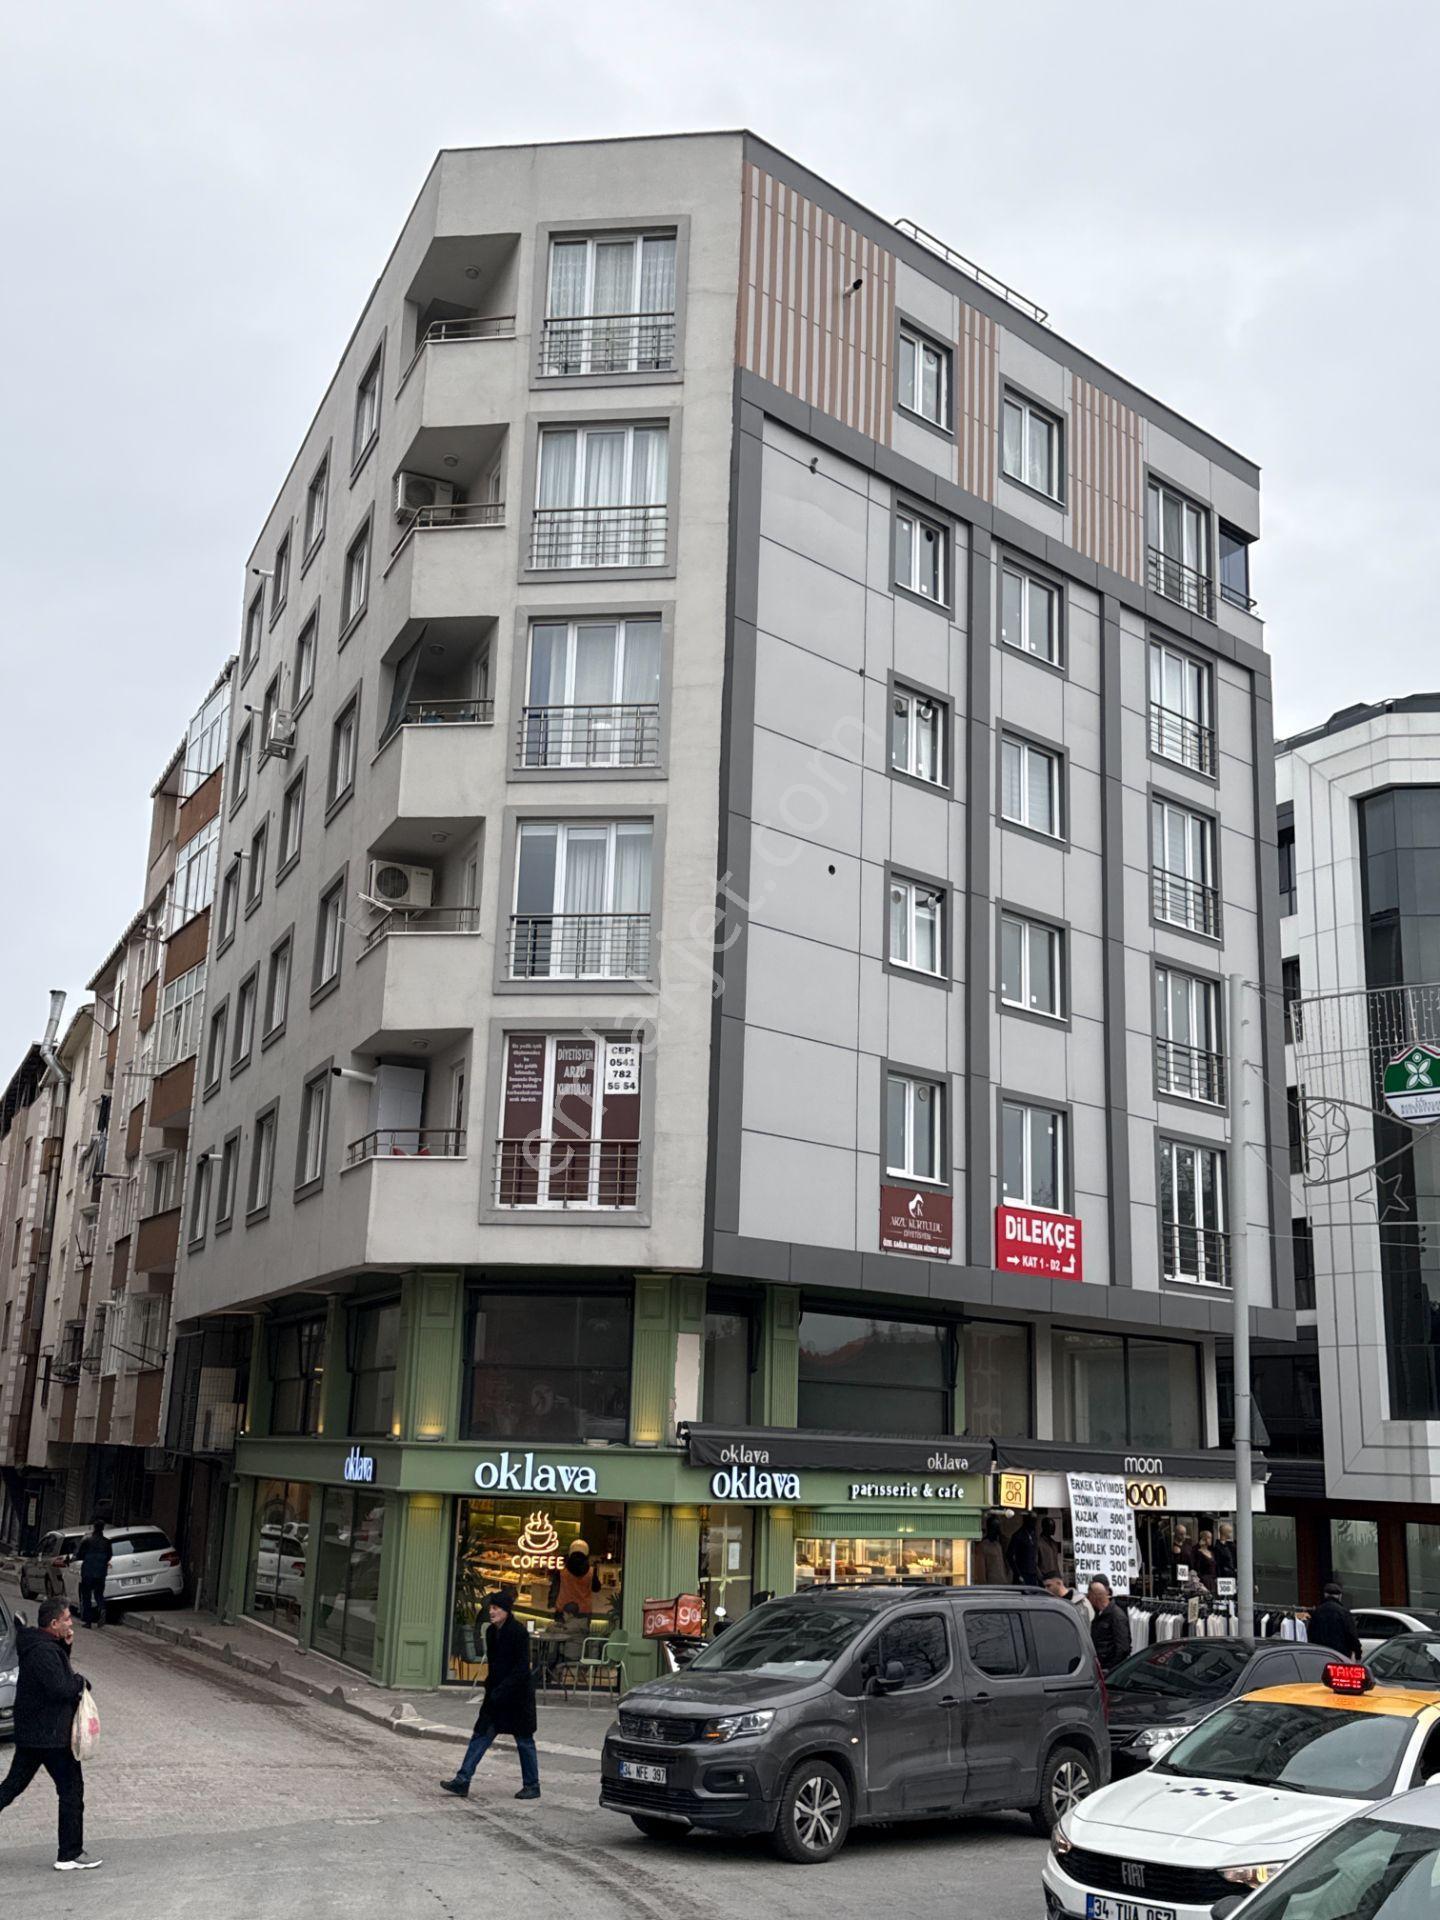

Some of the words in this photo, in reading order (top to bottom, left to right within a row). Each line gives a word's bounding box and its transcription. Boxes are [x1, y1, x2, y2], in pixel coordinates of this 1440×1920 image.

[557, 1046, 594, 1061] DİYETİSYEN
[611, 1047, 635, 1055] CEP:
[609, 1059, 635, 1067] 0541
[563, 1066, 587, 1079] ARZU
[613, 1070, 632, 1078] 782
[607, 1082, 621, 1090] 55
[623, 1082, 636, 1090] 54
[1022, 1255, 1038, 1269] KAT
[1039, 1257, 1044, 1270] 1
[720, 1444, 770, 1464] oklava
[927, 1452, 969, 1471] oklava
[344, 1446, 374, 1482] oklava
[1124, 1456, 1163, 1474] moon
[474, 1452, 598, 1494] oklava
[712, 1466, 801, 1499] oklava
[851, 1482, 918, 1499] patisserie
[922, 1483, 933, 1498] &
[937, 1484, 965, 1499] cafe
[1071, 1478, 1094, 1492] ERKEK
[1126, 1482, 1168, 1507] oon
[1075, 1540, 1107, 1556] GÖMLEK
[511, 1554, 565, 1570] COFFEE
[1075, 1558, 1101, 1571] PENYE
[1110, 1561, 1127, 1572] 300
[1111, 1575, 1127, 1587] 500
[624, 1762, 632, 1776] 34
[636, 1765, 649, 1780] NFE
[652, 1767, 666, 1782] 397
[1121, 1861, 1146, 1889] FIAT
[1094, 1899, 1109, 1919] 34
